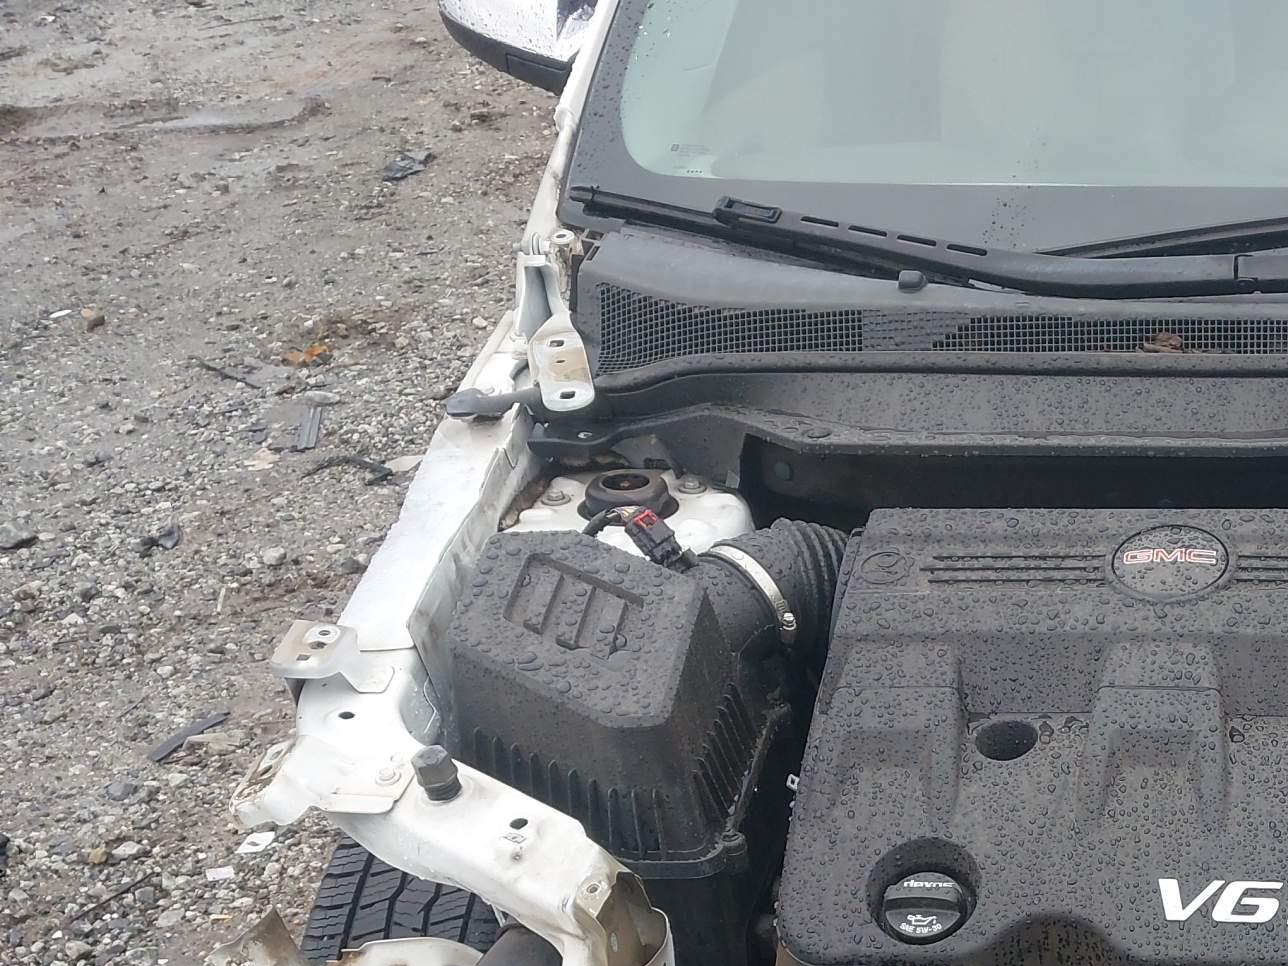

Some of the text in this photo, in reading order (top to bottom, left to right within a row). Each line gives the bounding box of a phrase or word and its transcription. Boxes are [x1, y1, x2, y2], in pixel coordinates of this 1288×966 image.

[1123, 548, 1217, 565] GMC
[1157, 878, 1284, 923] V6
[900, 923, 942, 933] SAE 5W-30
